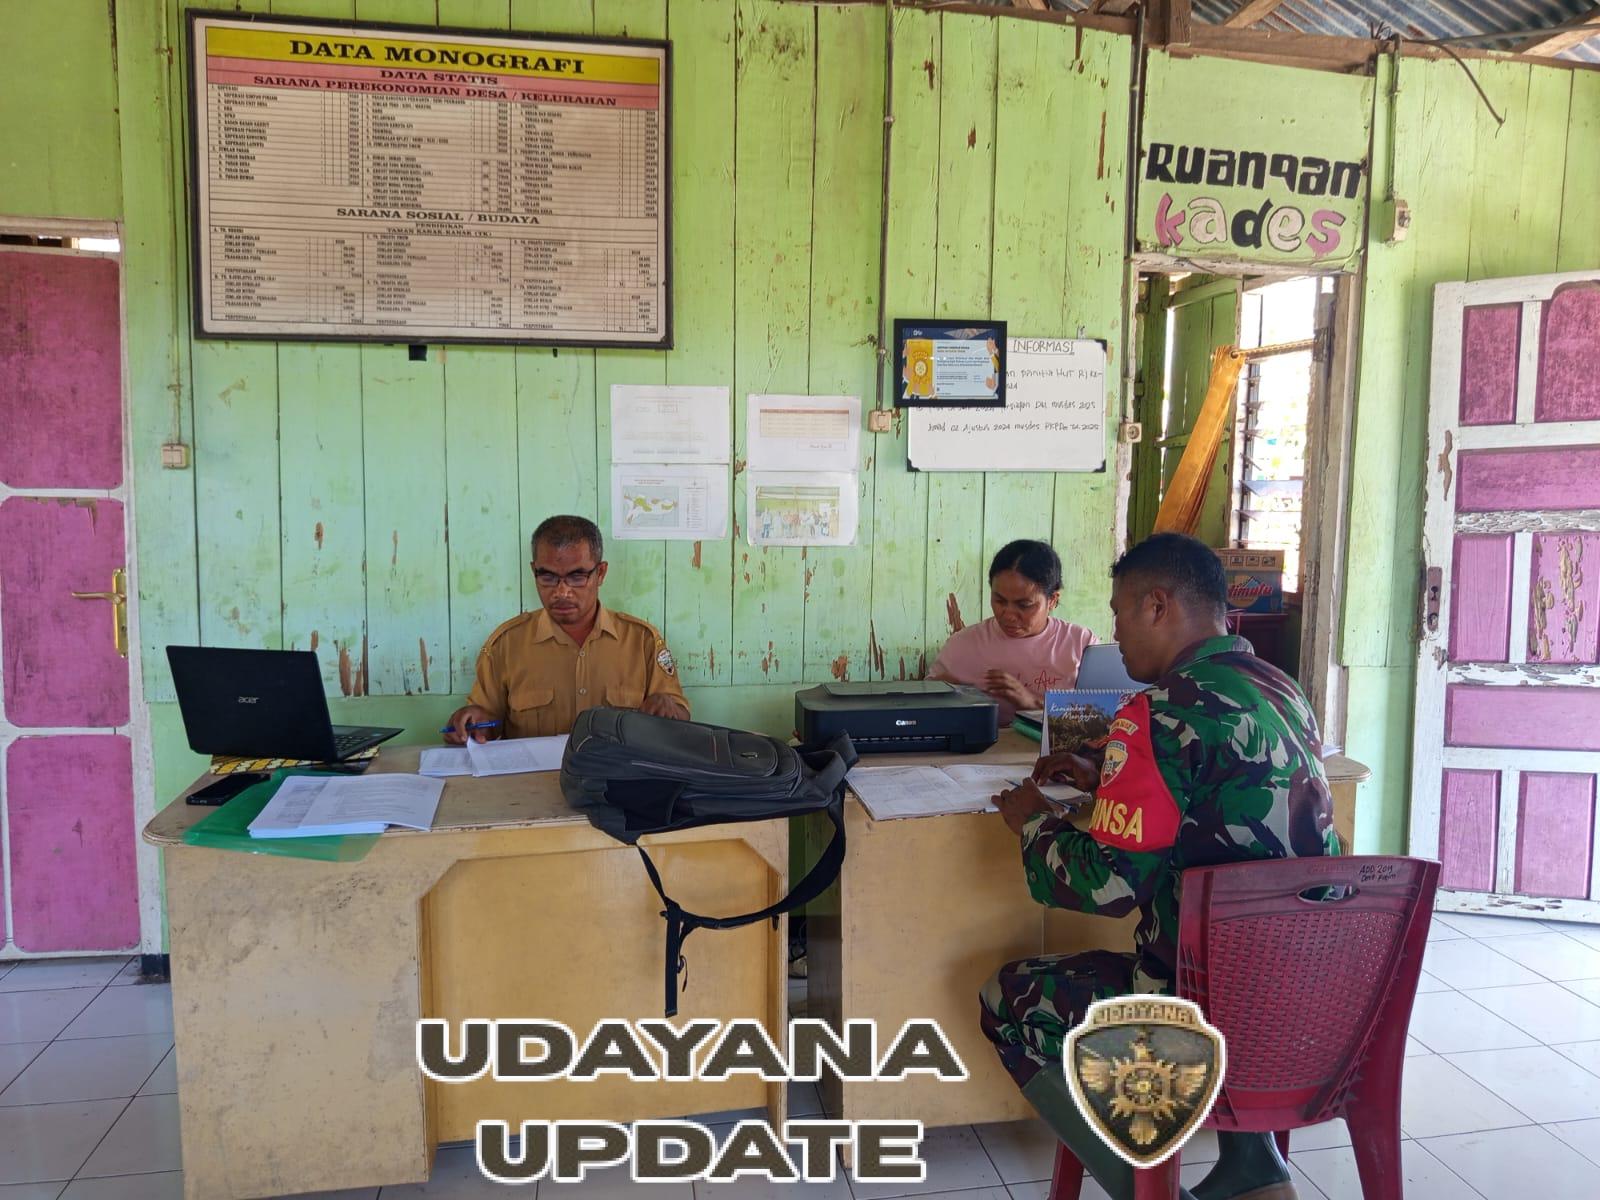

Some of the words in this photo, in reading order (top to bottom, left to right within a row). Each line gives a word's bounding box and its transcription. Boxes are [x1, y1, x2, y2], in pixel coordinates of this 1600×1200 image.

[290, 40, 375, 60] DATA
[384, 46, 585, 74] MONOGRAFI
[380, 69, 430, 81] DATA
[433, 73, 499, 84] STATIS
[253, 76, 321, 89] SARANA
[326, 79, 461, 97] PEREKONOMIAN
[464, 87, 508, 100] DESA
[522, 92, 617, 106] KELURAHAN
[336, 208, 402, 219] SARANA
[406, 211, 464, 221] SOSIAL
[478, 214, 540, 224] BUDAYA
[1154, 192, 1347, 257] kades
[238, 695, 260, 704] acer
